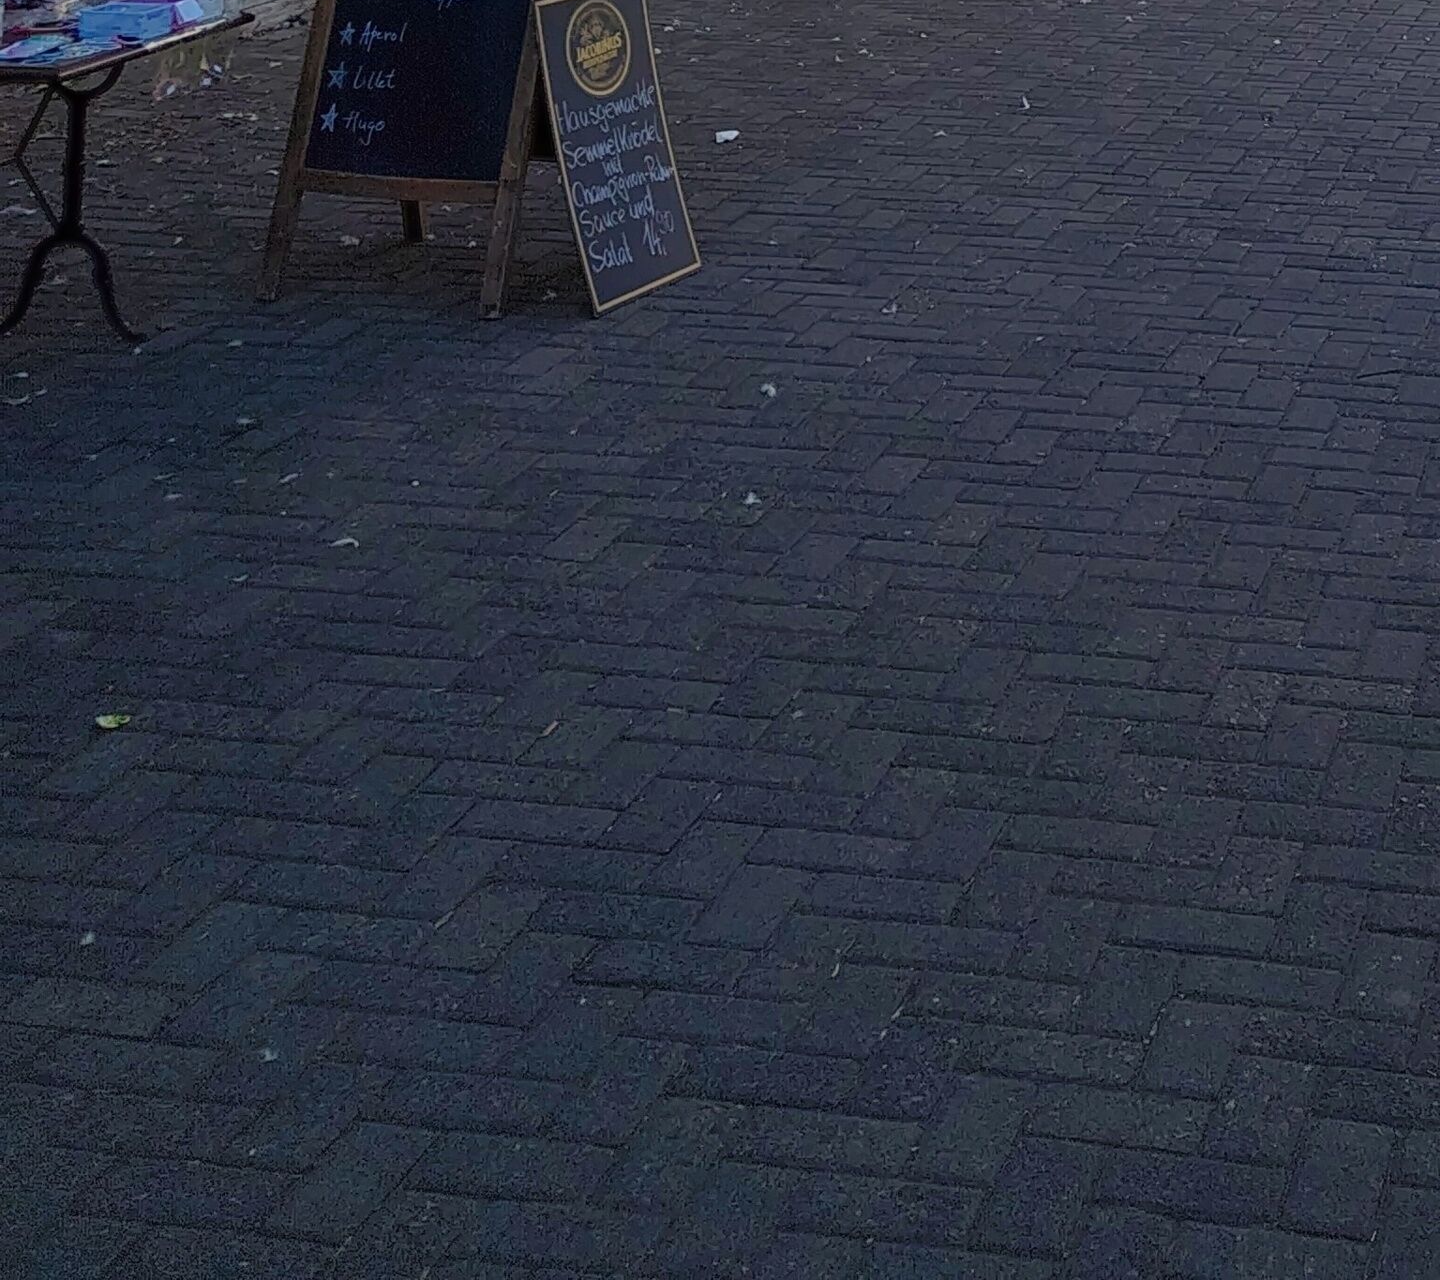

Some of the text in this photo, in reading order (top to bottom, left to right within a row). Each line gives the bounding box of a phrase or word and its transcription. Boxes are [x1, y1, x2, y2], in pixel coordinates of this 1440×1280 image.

[360, 20, 407, 52] Aperol
[353, 65, 396, 89] Lillet
[555, 77, 655, 136] Hausgemachte
[342, 110, 385, 146] Hugo
[601, 152, 623, 177] mit
[580, 184, 655, 238] Sauce und
[588, 231, 633, 273] Salat
